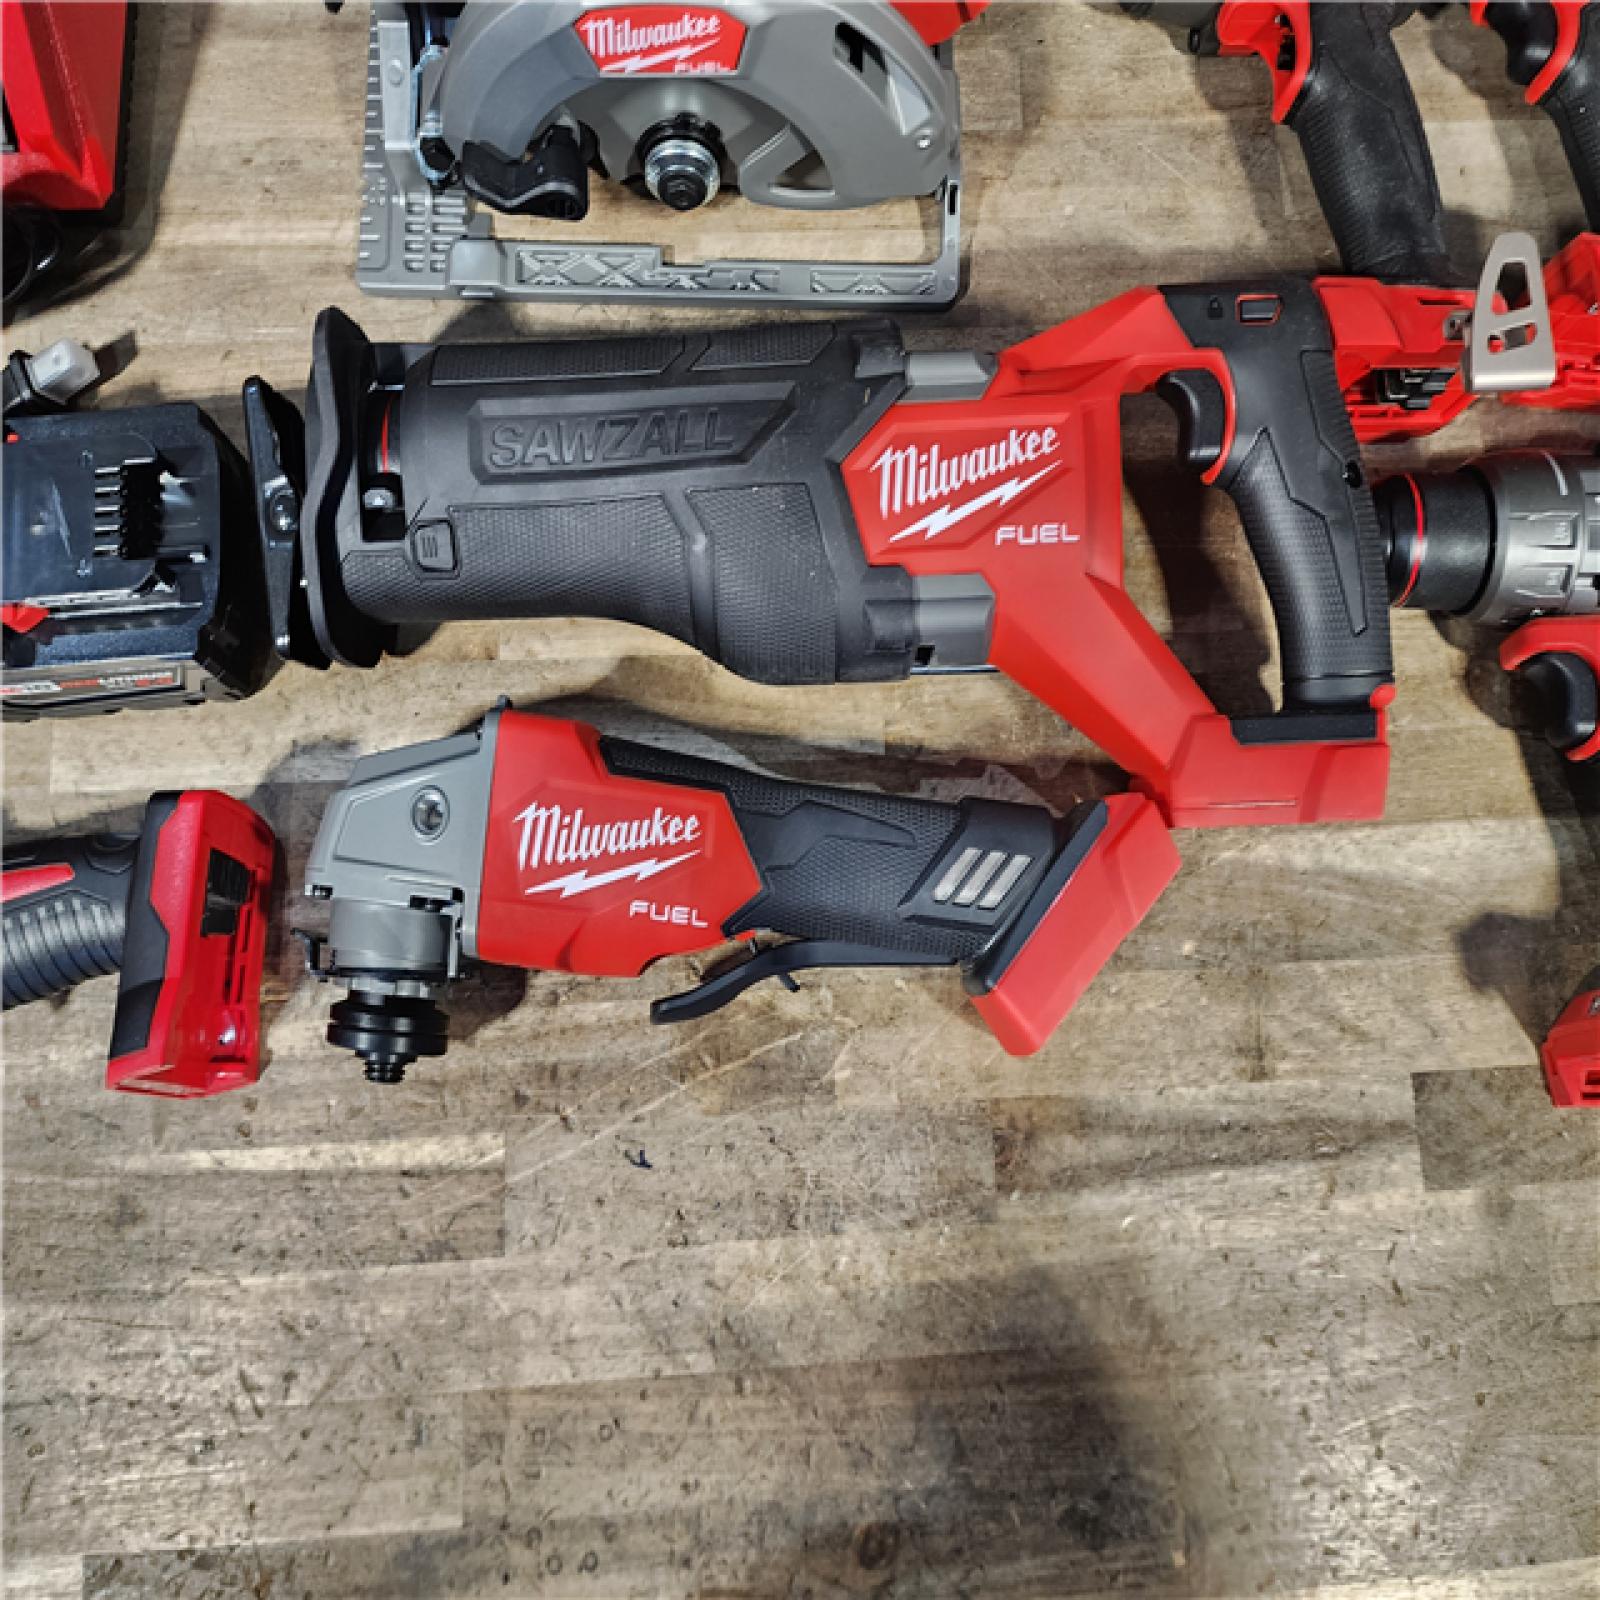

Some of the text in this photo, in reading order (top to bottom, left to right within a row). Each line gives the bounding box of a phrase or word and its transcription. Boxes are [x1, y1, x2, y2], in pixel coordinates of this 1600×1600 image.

[579, 12, 721, 57] Milwaukee
[489, 407, 734, 468] SAWZALL
[869, 427, 1061, 520] Milwaukee
[995, 522, 1081, 546] FUEL
[513, 800, 702, 873] Milwaukee
[629, 900, 709, 928] FUEL
